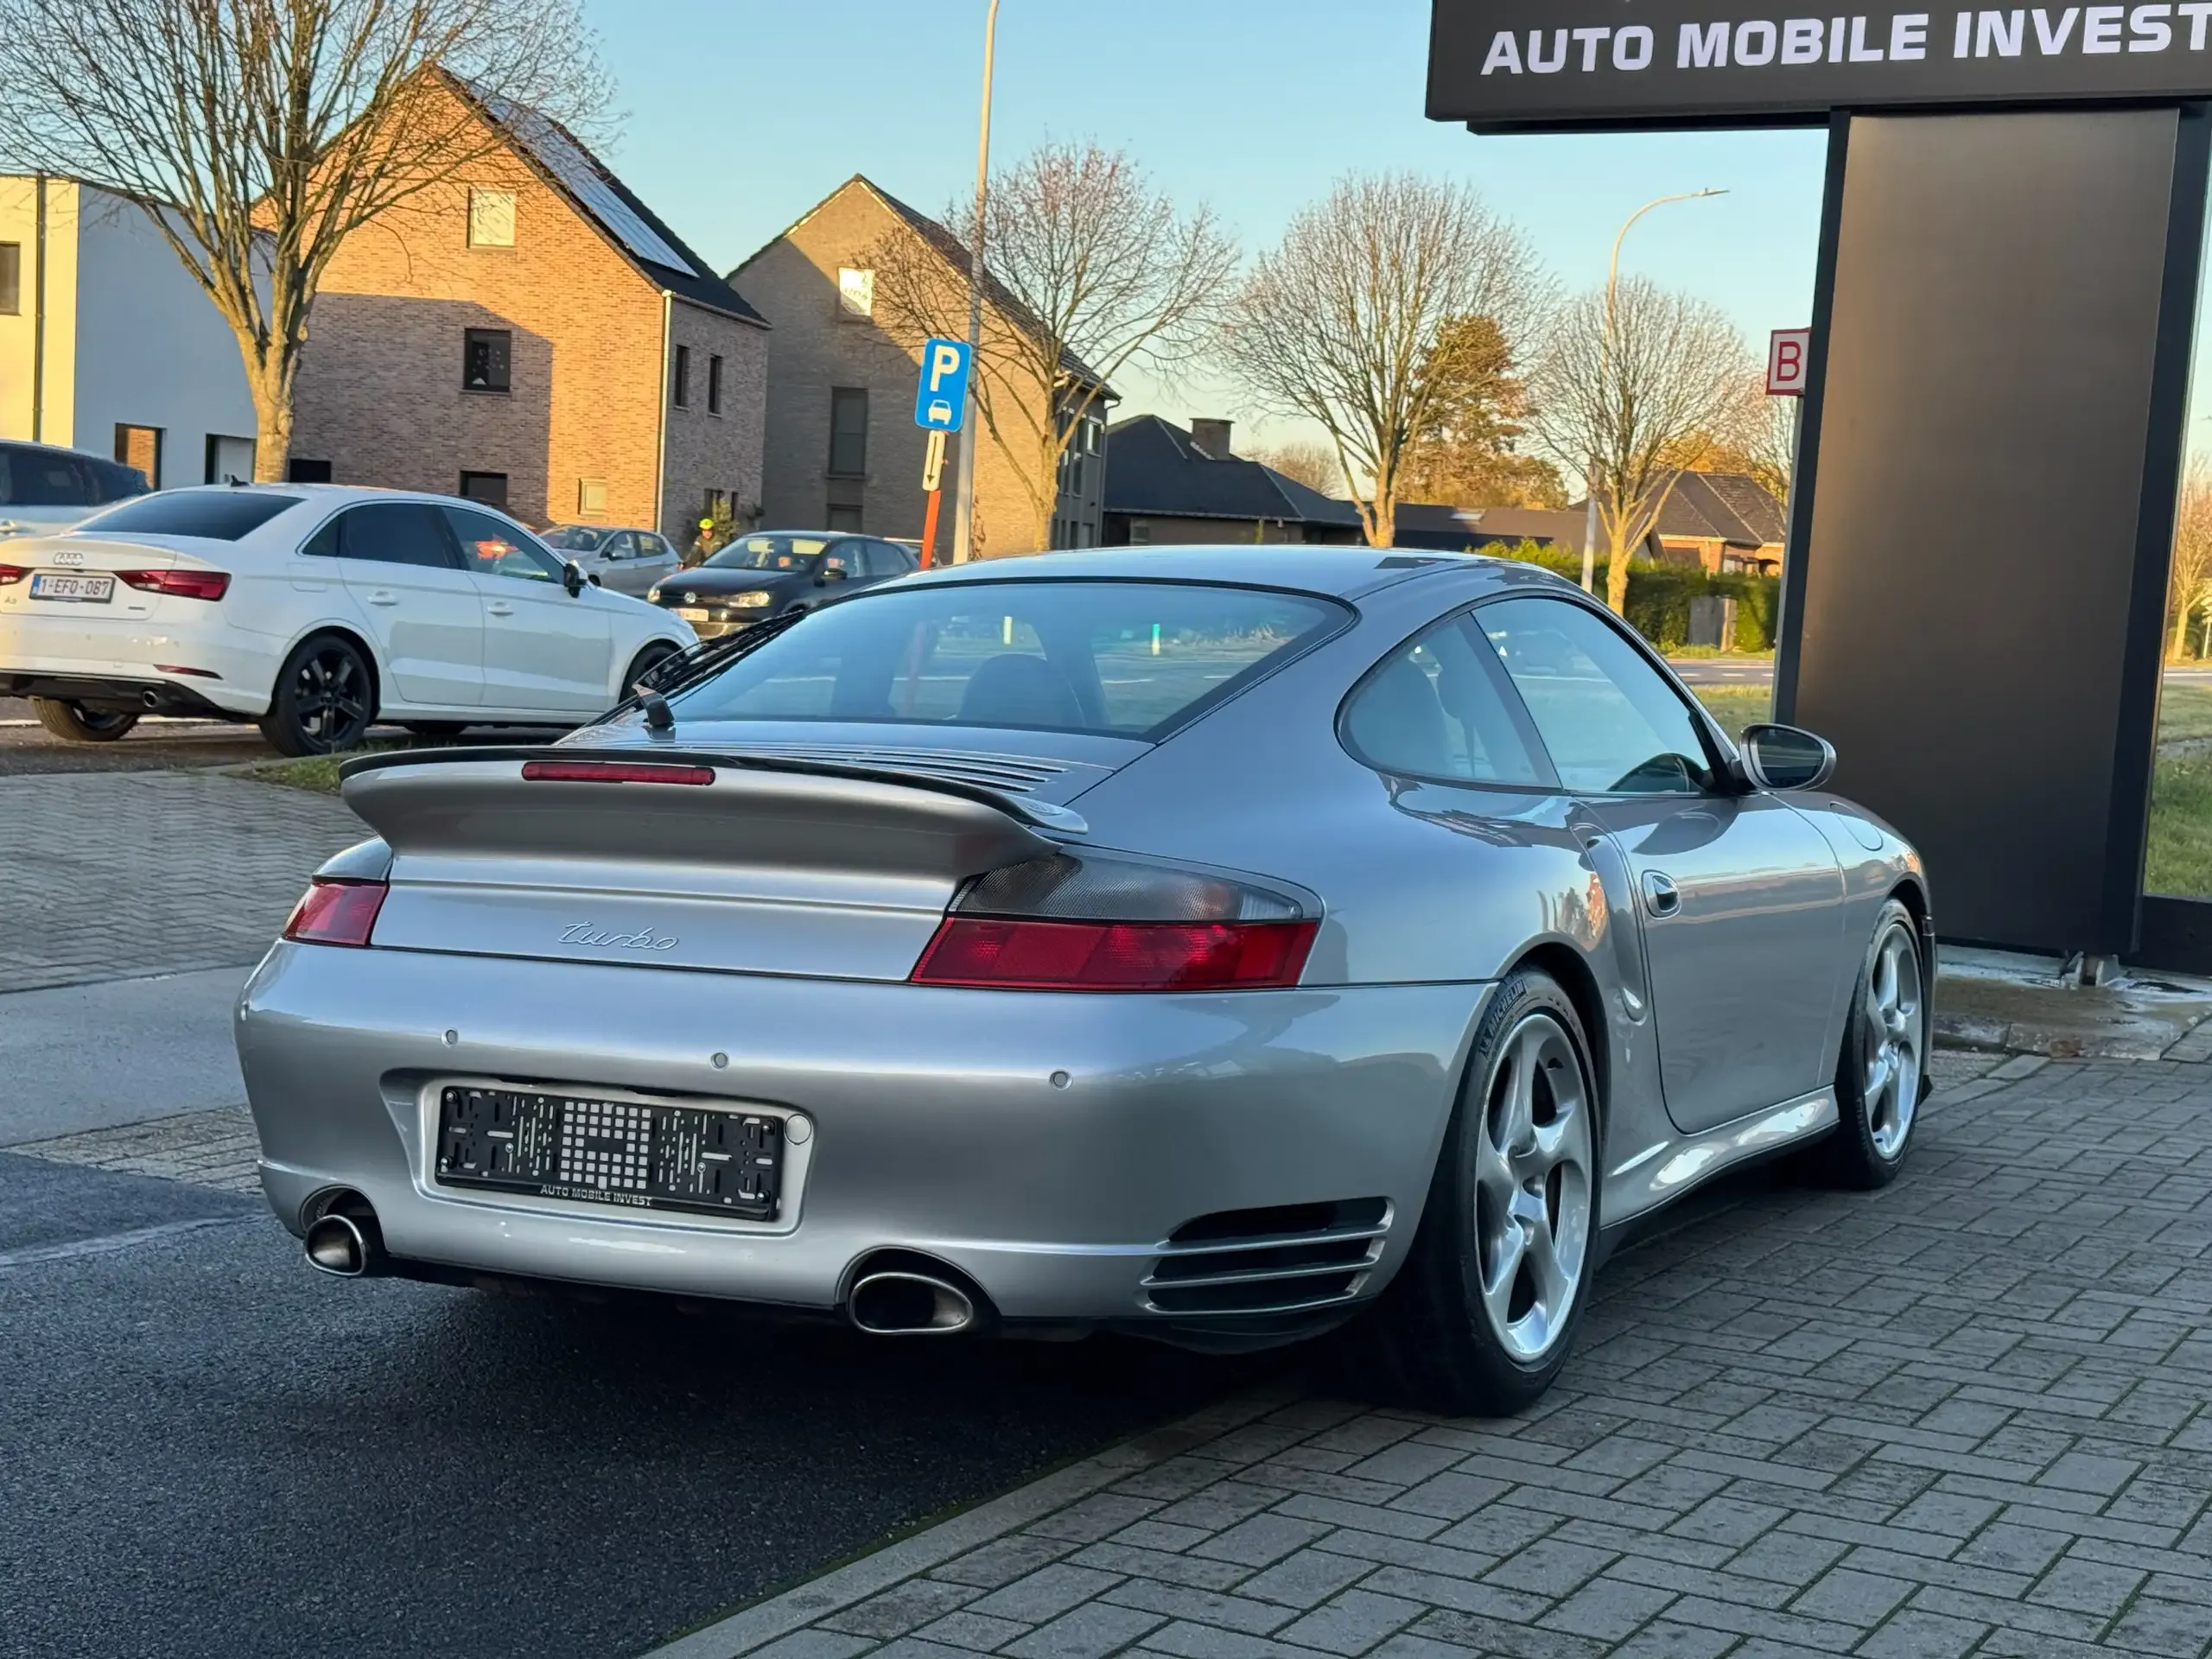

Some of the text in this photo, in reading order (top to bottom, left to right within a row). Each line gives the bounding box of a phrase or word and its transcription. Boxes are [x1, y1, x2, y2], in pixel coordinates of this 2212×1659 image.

[1480, 3, 2212, 75] AUTO MOBILE INVEST
[929, 345, 961, 391] P
[1776, 340, 1802, 382] B
[1487, 979, 1526, 1038] MICHELIN
[540, 1185, 652, 1205] AUTO MOBILE INVEST
